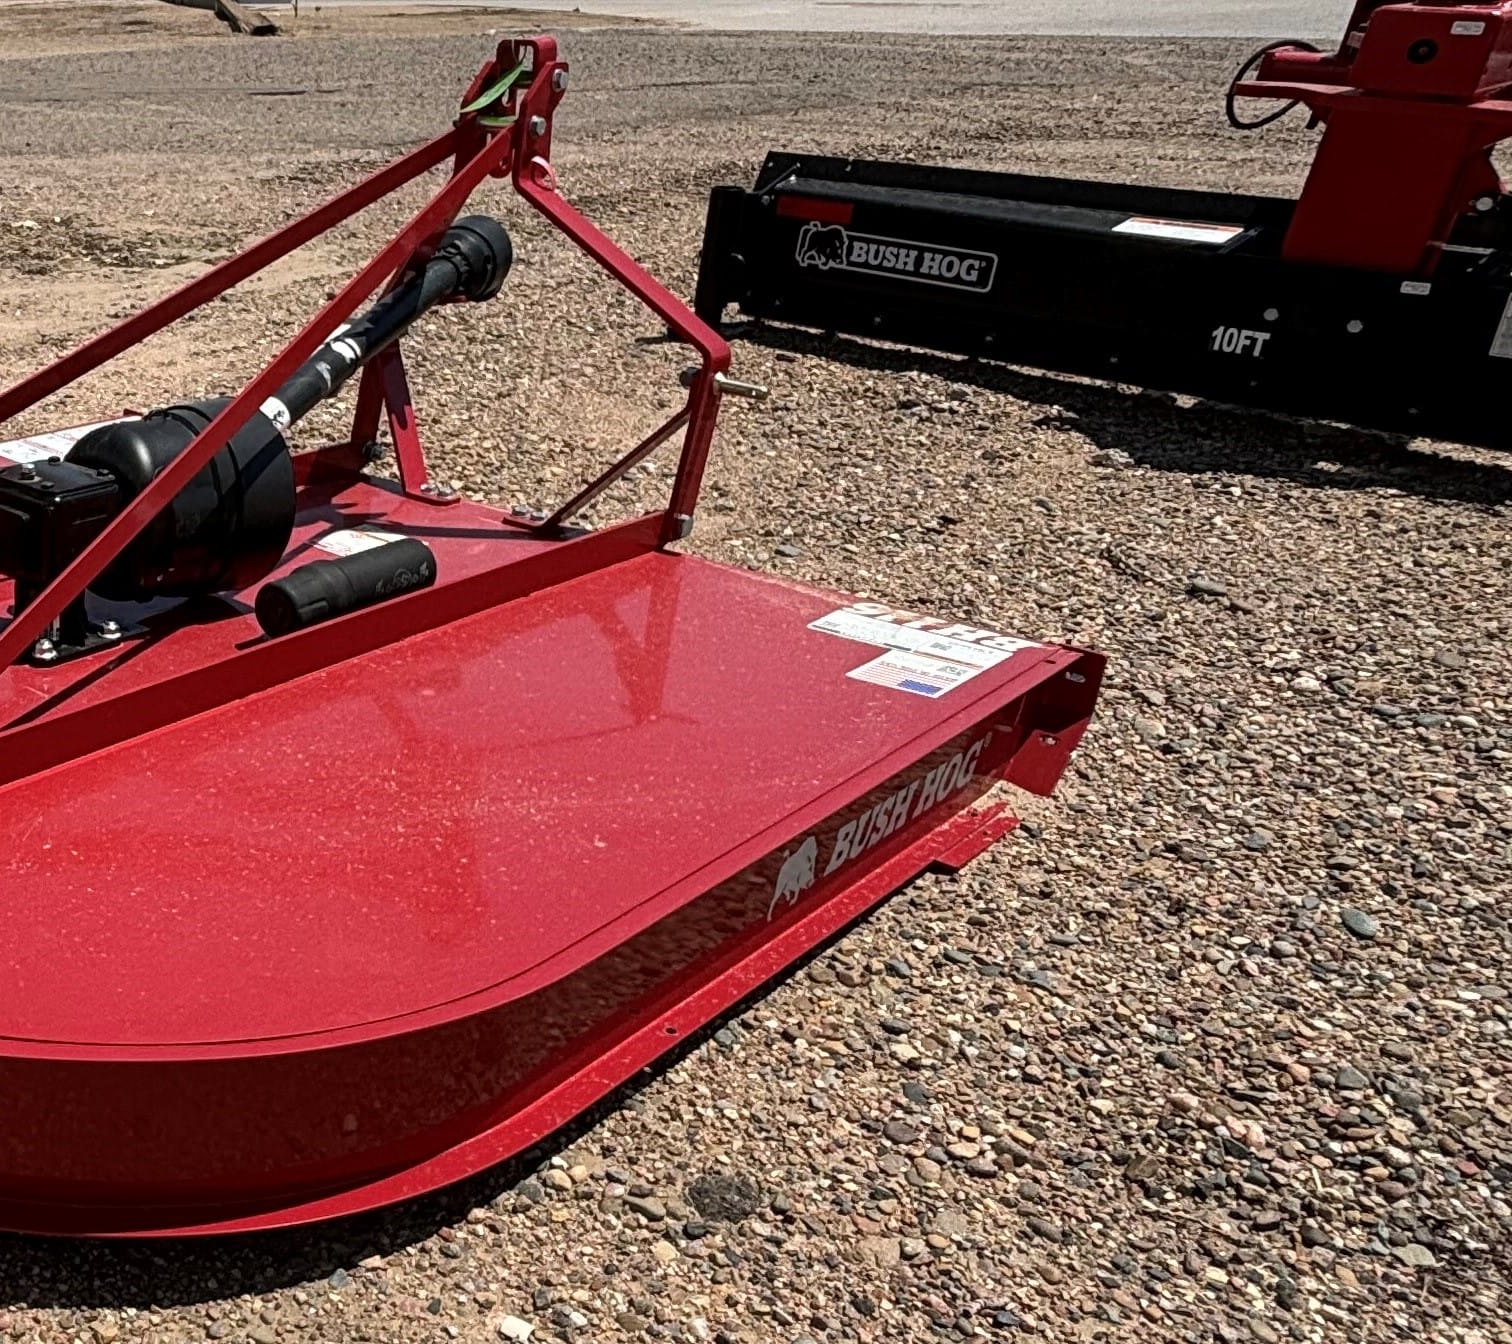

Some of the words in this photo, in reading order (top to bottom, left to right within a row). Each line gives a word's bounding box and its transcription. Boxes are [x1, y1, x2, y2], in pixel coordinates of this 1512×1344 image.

[849, 241, 918, 272] BUSH
[1211, 325, 1271, 357] 10FT
[824, 779, 922, 877] BUSH
